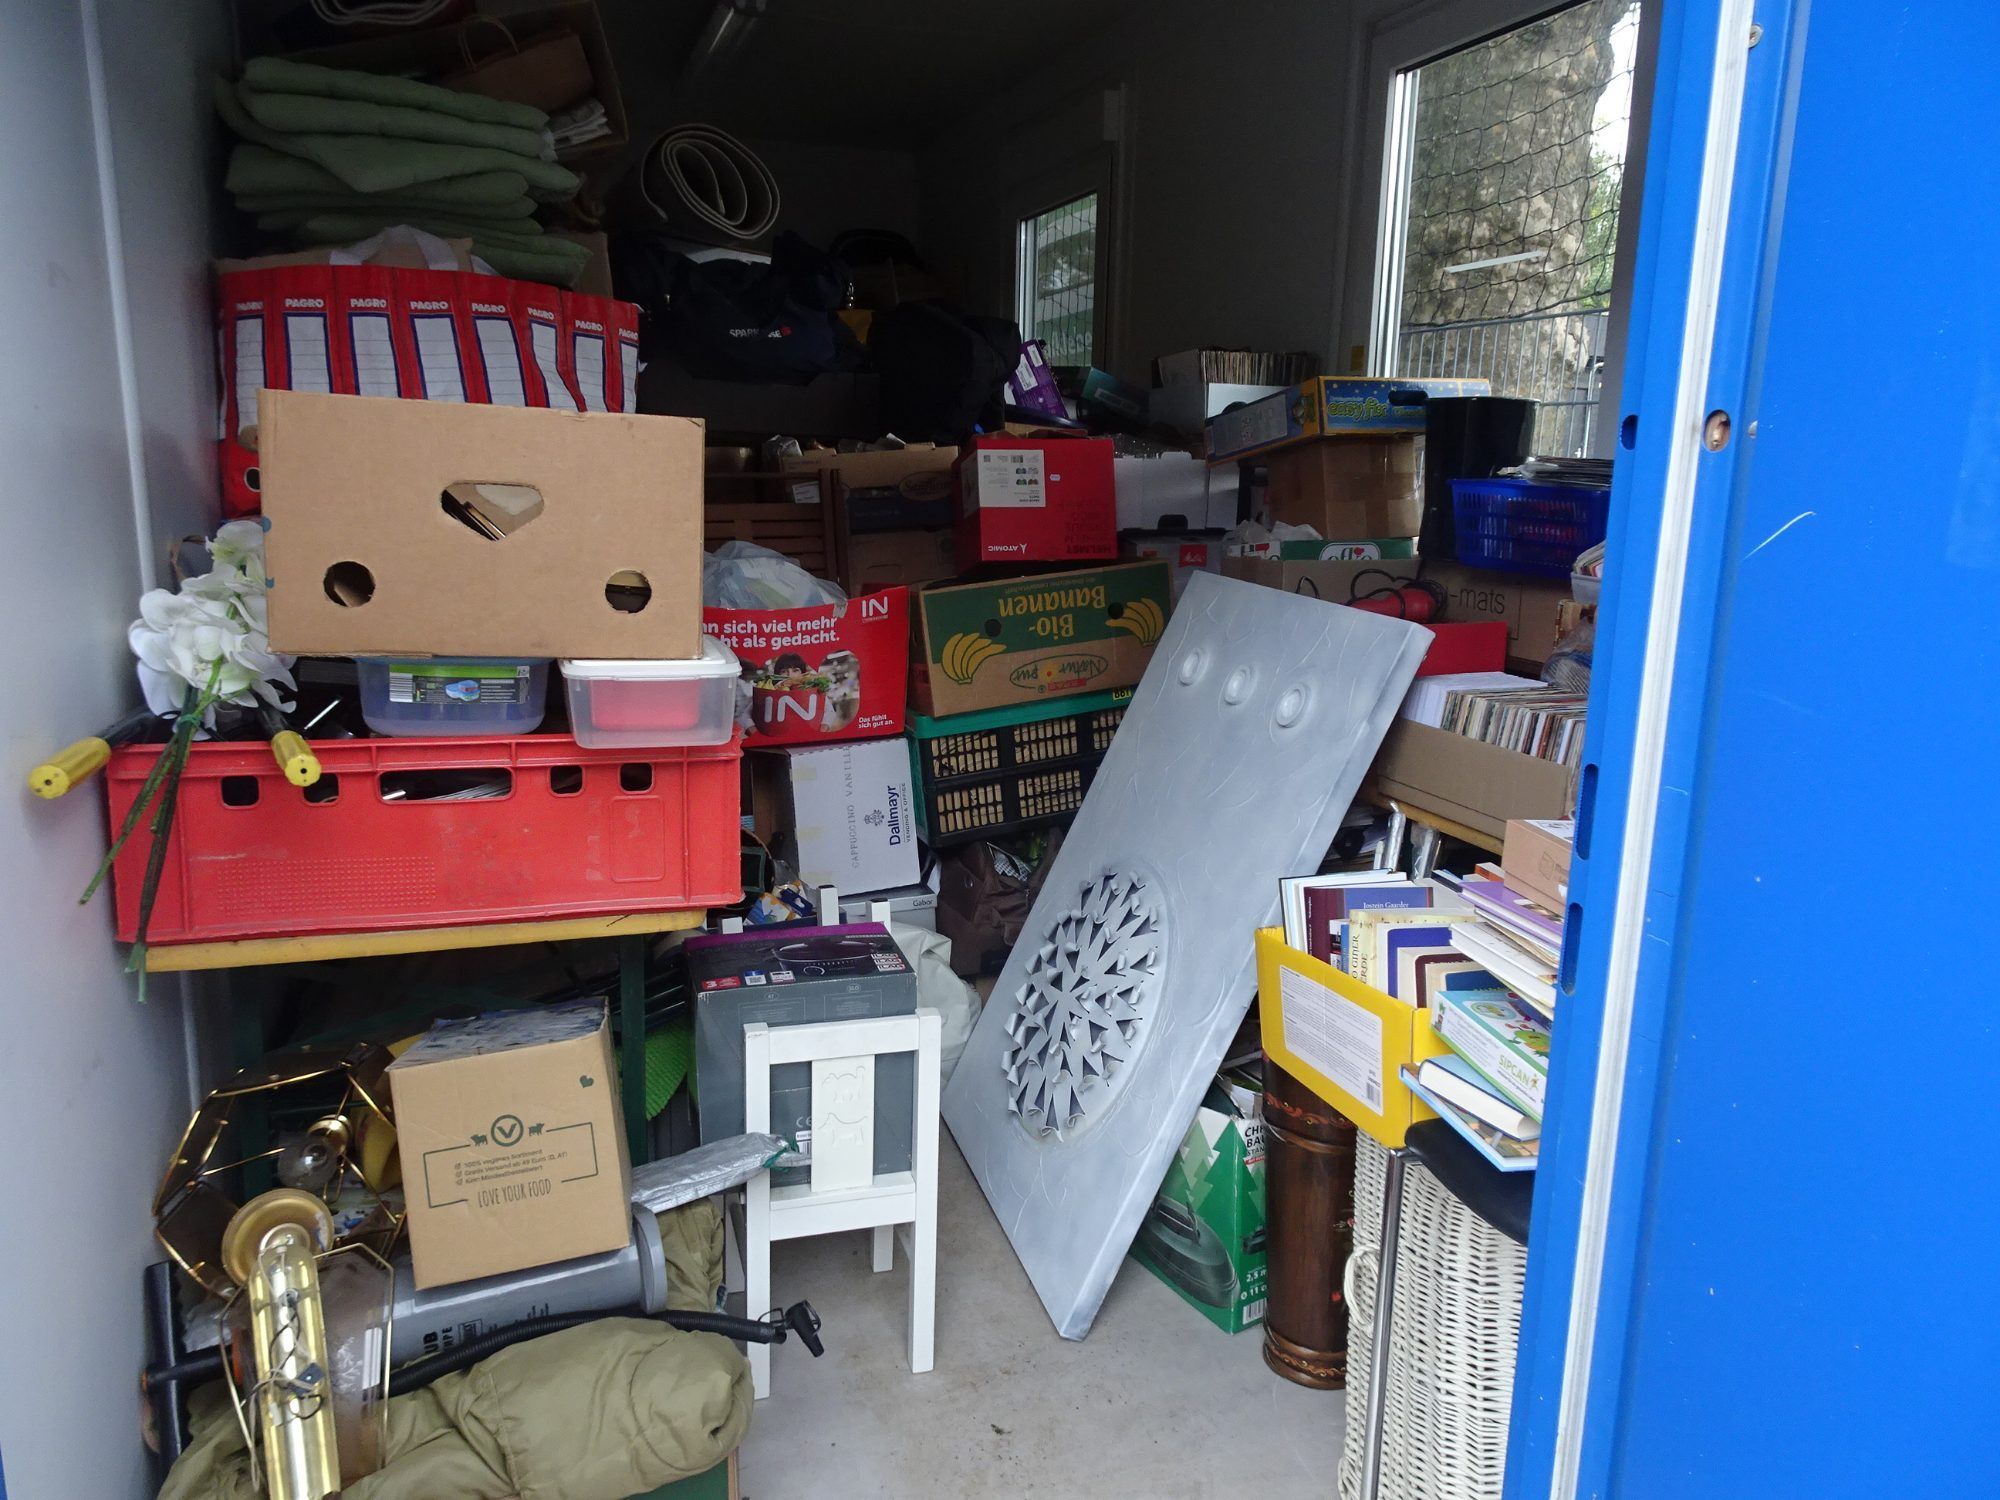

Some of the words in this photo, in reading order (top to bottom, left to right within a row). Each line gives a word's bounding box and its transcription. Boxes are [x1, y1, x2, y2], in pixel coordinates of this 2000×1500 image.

[285, 298, 324, 308] PAGRO
[350, 298, 387, 308] PAGRO
[410, 301, 448, 310] PAGRO
[472, 303, 505, 314] PAGRO
[528, 307, 555, 321] PAGRO
[575, 320, 603, 332] PAGRO
[618, 328, 639, 340] PAGRO
[987, 544, 1018, 552] ATOMIC
[861, 596, 888, 618] IN
[999, 585, 1106, 618] Bananen
[1448, 588, 1505, 614] -mats
[723, 620, 758, 634] sich
[762, 618, 793, 634] viel
[797, 616, 838, 632] mehr
[1028, 614, 1075, 640] Bio-
[743, 634, 767, 648] als
[771, 630, 840, 650] gedacht.
[764, 693, 818, 723] IN
[872, 714, 887, 722] fühlt
[872, 720, 884, 728] gut
[889, 785, 901, 846] Dallmayr
[848, 804, 860, 868] CAPPUCCINO
[904, 814, 912, 843] VENDING
[706, 980, 718, 988] 3
[1498, 1055, 1530, 1086] SIPCAN
[477, 1188, 500, 1208] LOVE
[502, 1183, 528, 1202] YOUR
[528, 1178, 552, 1198] FOOD
